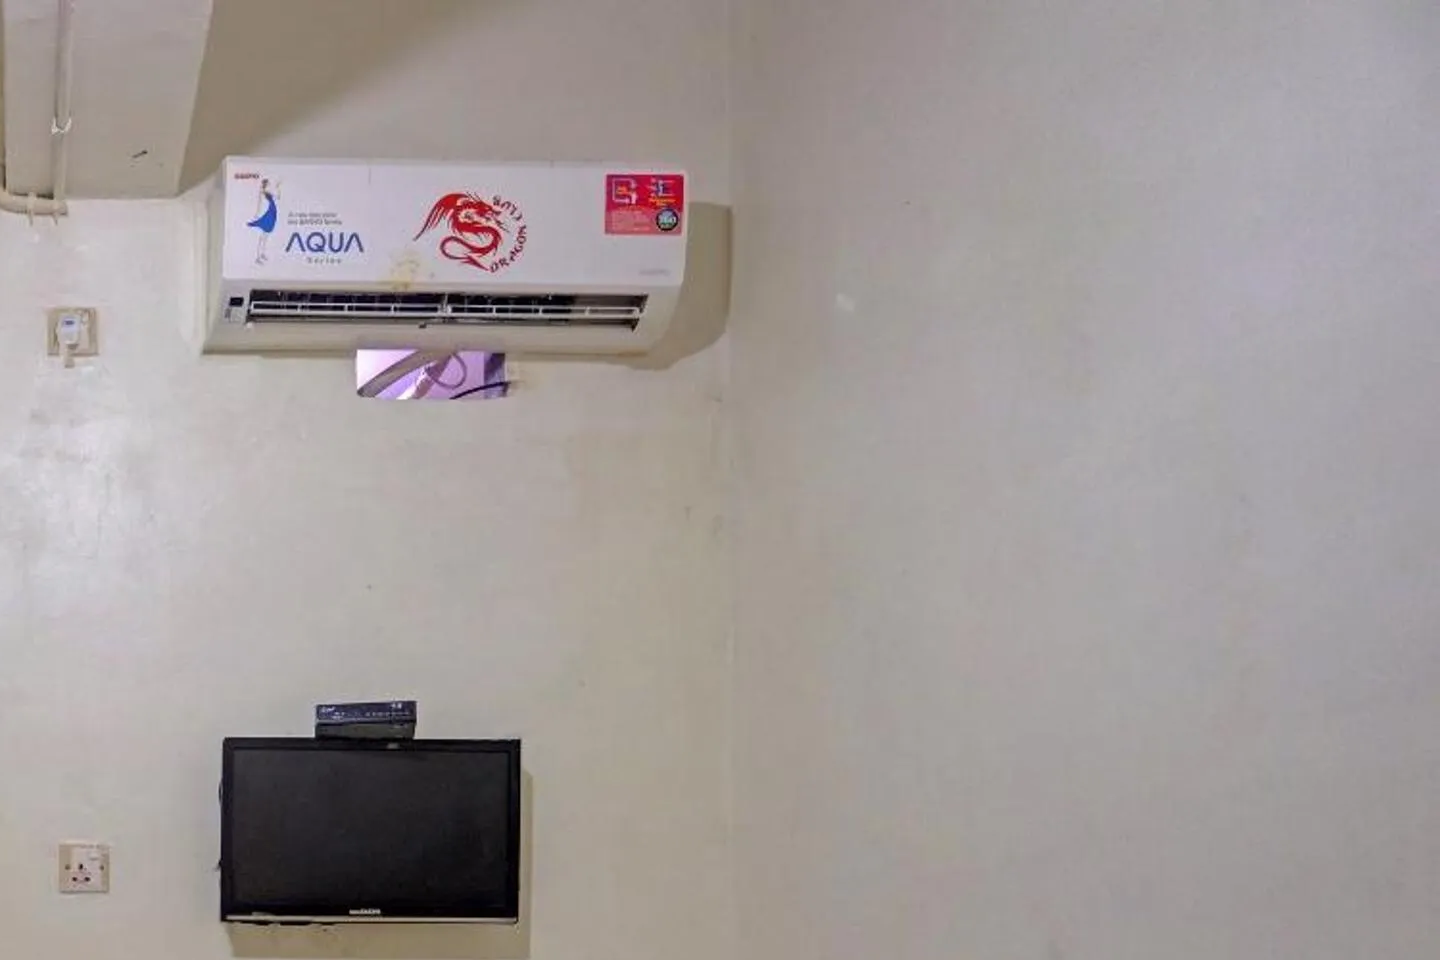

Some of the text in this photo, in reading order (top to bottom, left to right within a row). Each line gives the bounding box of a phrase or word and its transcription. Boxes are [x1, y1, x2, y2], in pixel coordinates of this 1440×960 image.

[285, 231, 364, 253] AQUA
[490, 195, 527, 273] DRAGON CLUB
